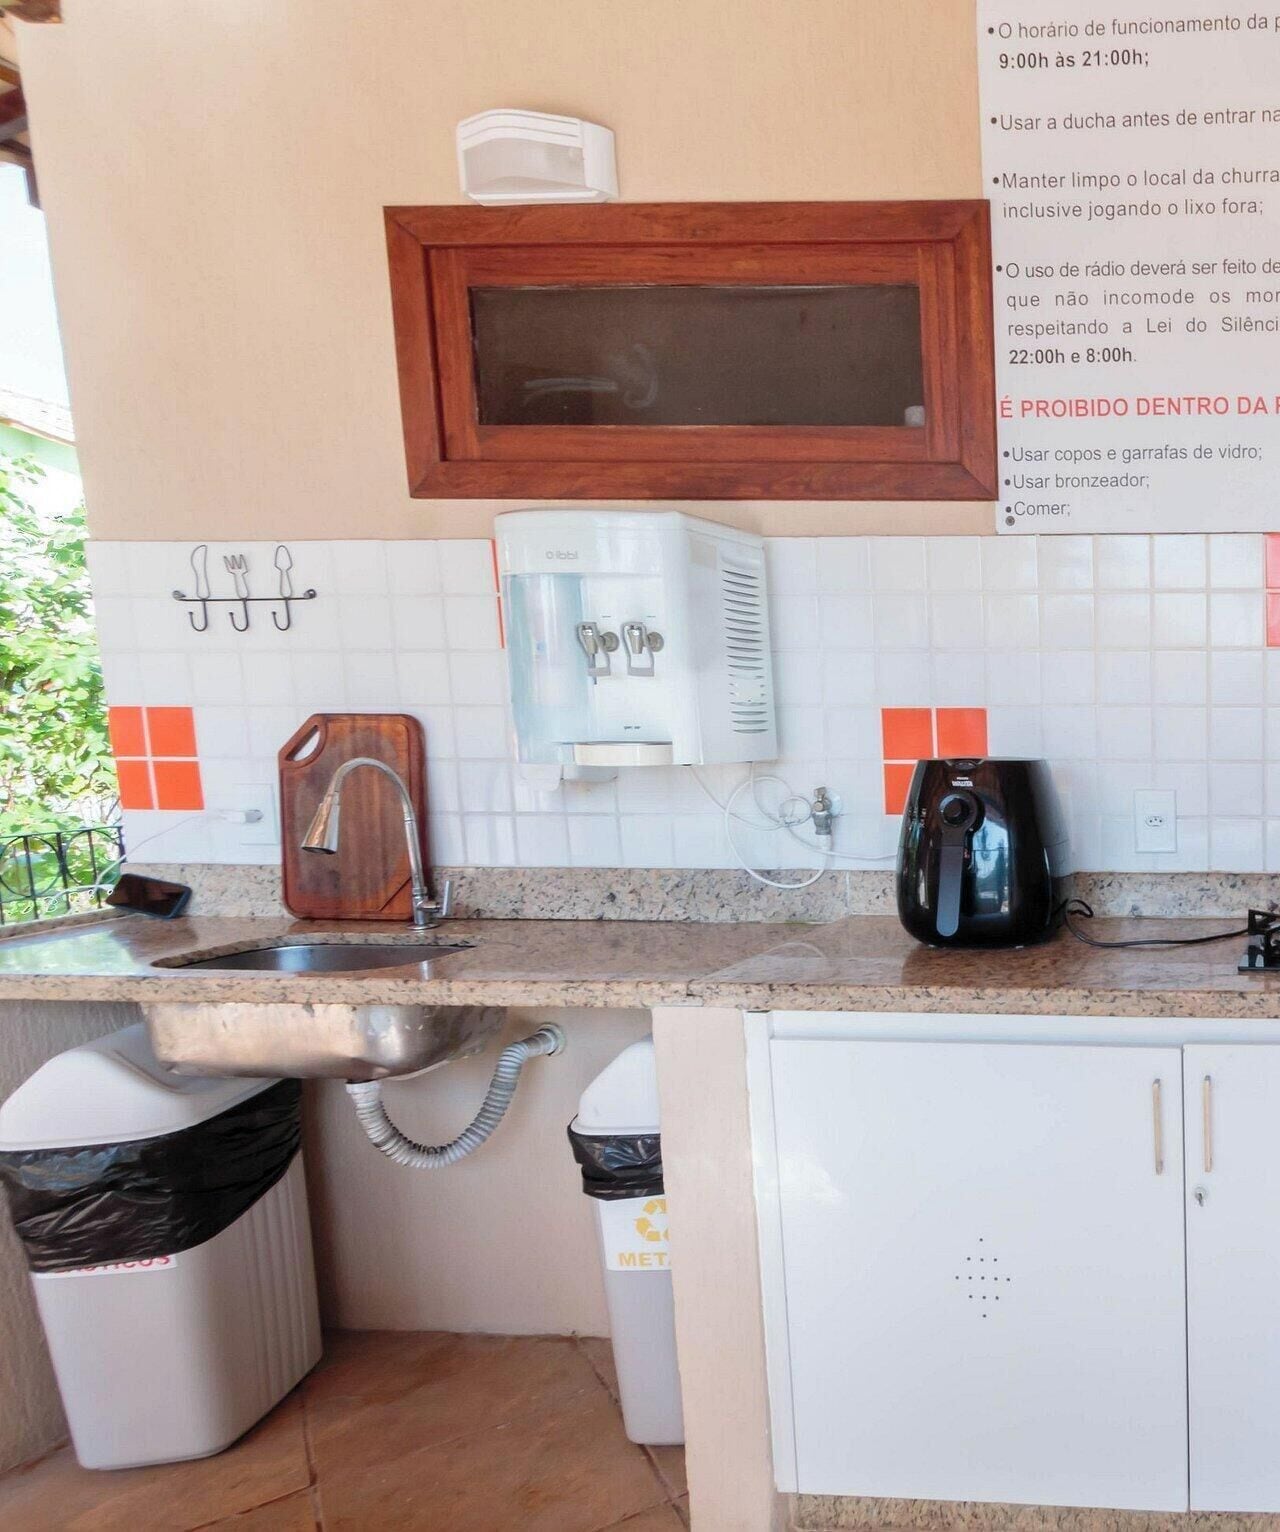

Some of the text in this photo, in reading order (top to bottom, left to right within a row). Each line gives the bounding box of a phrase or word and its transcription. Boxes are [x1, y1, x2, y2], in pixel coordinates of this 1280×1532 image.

[999, 23, 1012, 39] O
[1019, 21, 1078, 38] horário
[1085, 20, 1105, 36] de
[1112, 16, 1240, 34] funcionamento
[1247, 14, 1267, 29] da
[1000, 49, 1149, 68] 9:00h às 21:00h;
[1001, 115, 1041, 130] Usar
[1047, 118, 1056, 129] a
[1064, 113, 1115, 129] ducha
[1123, 112, 1169, 127] antes
[1176, 109, 1197, 125] de
[1204, 109, 1255, 124] entrar
[1003, 173, 1065, 188] Manter
[1072, 172, 1120, 191] limpo
[1127, 175, 1137, 186] o
[1144, 169, 1185, 185] local
[1193, 169, 1214, 184] da
[1004, 198, 1263, 221] inclusive jogando o lixo fora;
[1006, 263, 1019, 278] O
[1026, 266, 1054, 278] uso
[1060, 262, 1079, 277] de
[1086, 261, 1124, 276] rádio
[1131, 260, 1185, 275] deverá
[1192, 263, 1217, 274] ser
[1223, 259, 1256, 274] feito
[1007, 295, 1039, 310] que
[1056, 291, 1088, 306] não
[1104, 289, 1194, 305] incomode
[1210, 292, 1230, 303] os
[1008, 319, 1108, 338] respeitando
[1123, 322, 1132, 333] a
[1147, 318, 1171, 333] Lei
[1186, 317, 1206, 332] do
[1009, 347, 1136, 364] 22:00h e 8:00h.
[1000, 395, 1013, 418] É
[1021, 398, 1128, 417] PROIBIDO
[1137, 397, 1228, 415] DENTRO
[1238, 397, 1268, 414] DA
[1012, 444, 1262, 464] Usar copos e garrafas de vidro;
[1014, 473, 1150, 489] Usar bronzeador;
[1013, 501, 1071, 519] Comer;
[618, 1252, 671, 1267] MET
